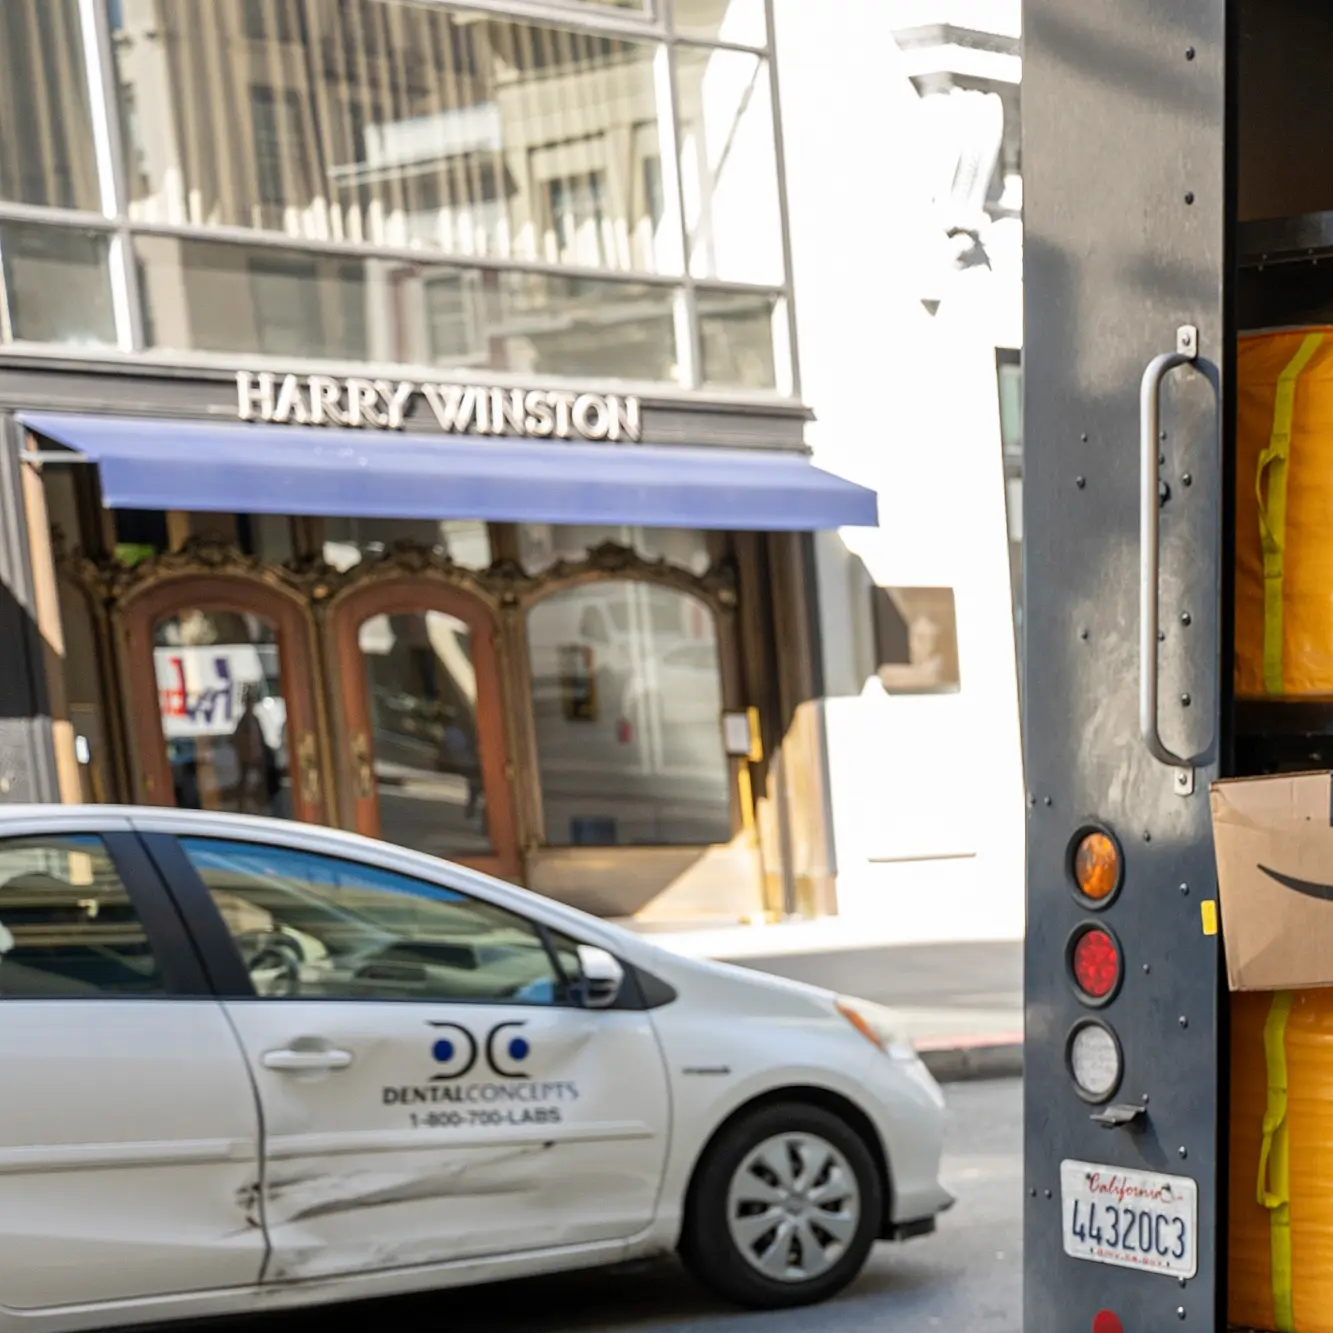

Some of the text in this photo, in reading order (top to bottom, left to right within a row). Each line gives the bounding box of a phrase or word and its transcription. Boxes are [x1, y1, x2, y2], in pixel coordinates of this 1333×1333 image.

[236, 371, 641, 442] HARRY WINSTON
[410, 1107, 563, 1128] 1-800-700-LABS
[1087, 1172, 1163, 1203] California
[1073, 1200, 1185, 1259] 44320C3
